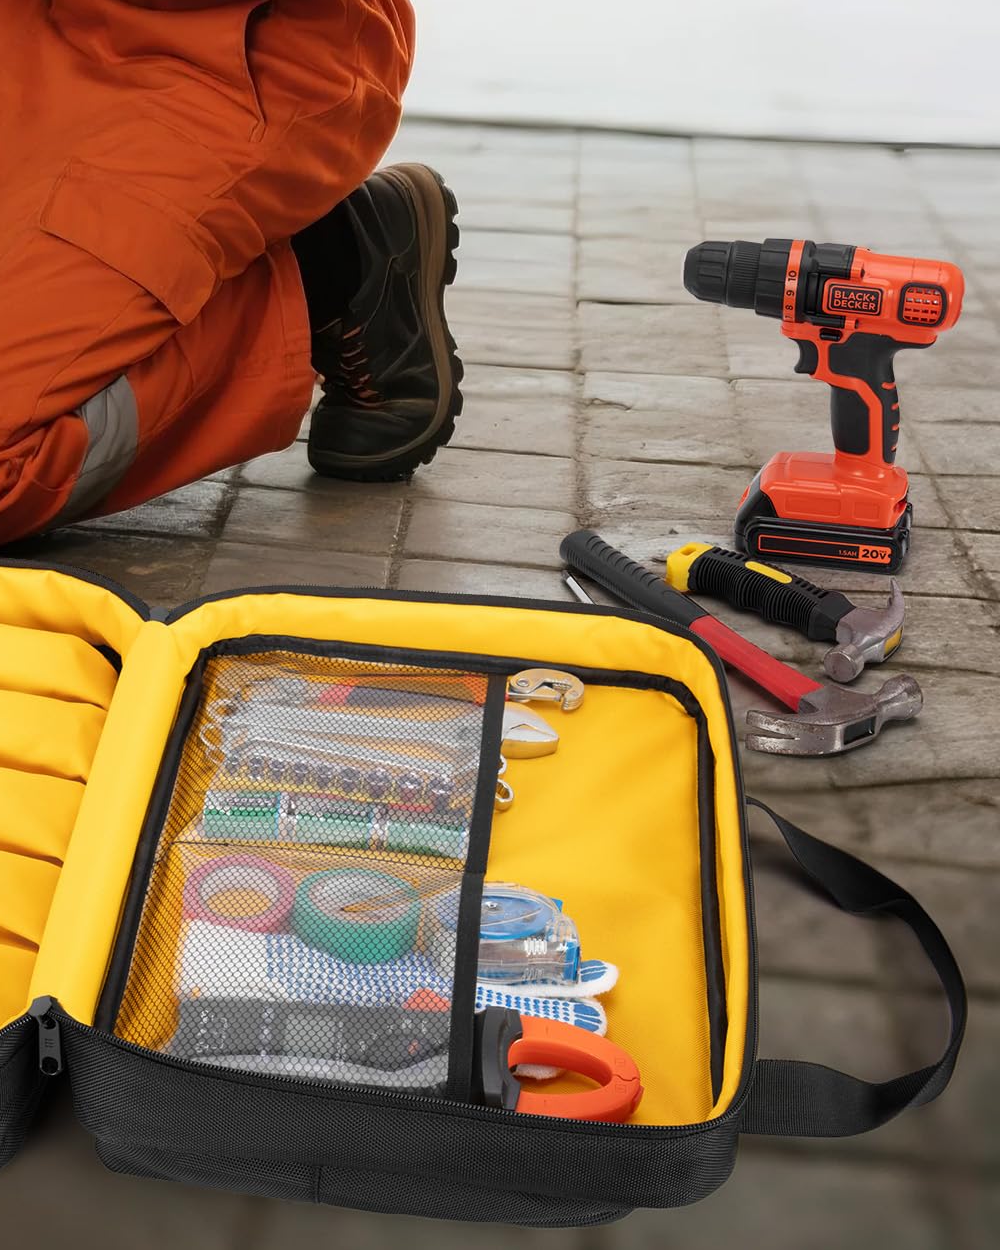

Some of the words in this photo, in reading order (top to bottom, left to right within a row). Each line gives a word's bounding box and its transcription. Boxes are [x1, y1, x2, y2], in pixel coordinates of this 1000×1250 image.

[788, 270, 796, 281] 10
[834, 290, 876, 301] BLACK+
[833, 299, 876, 310] DECKER
